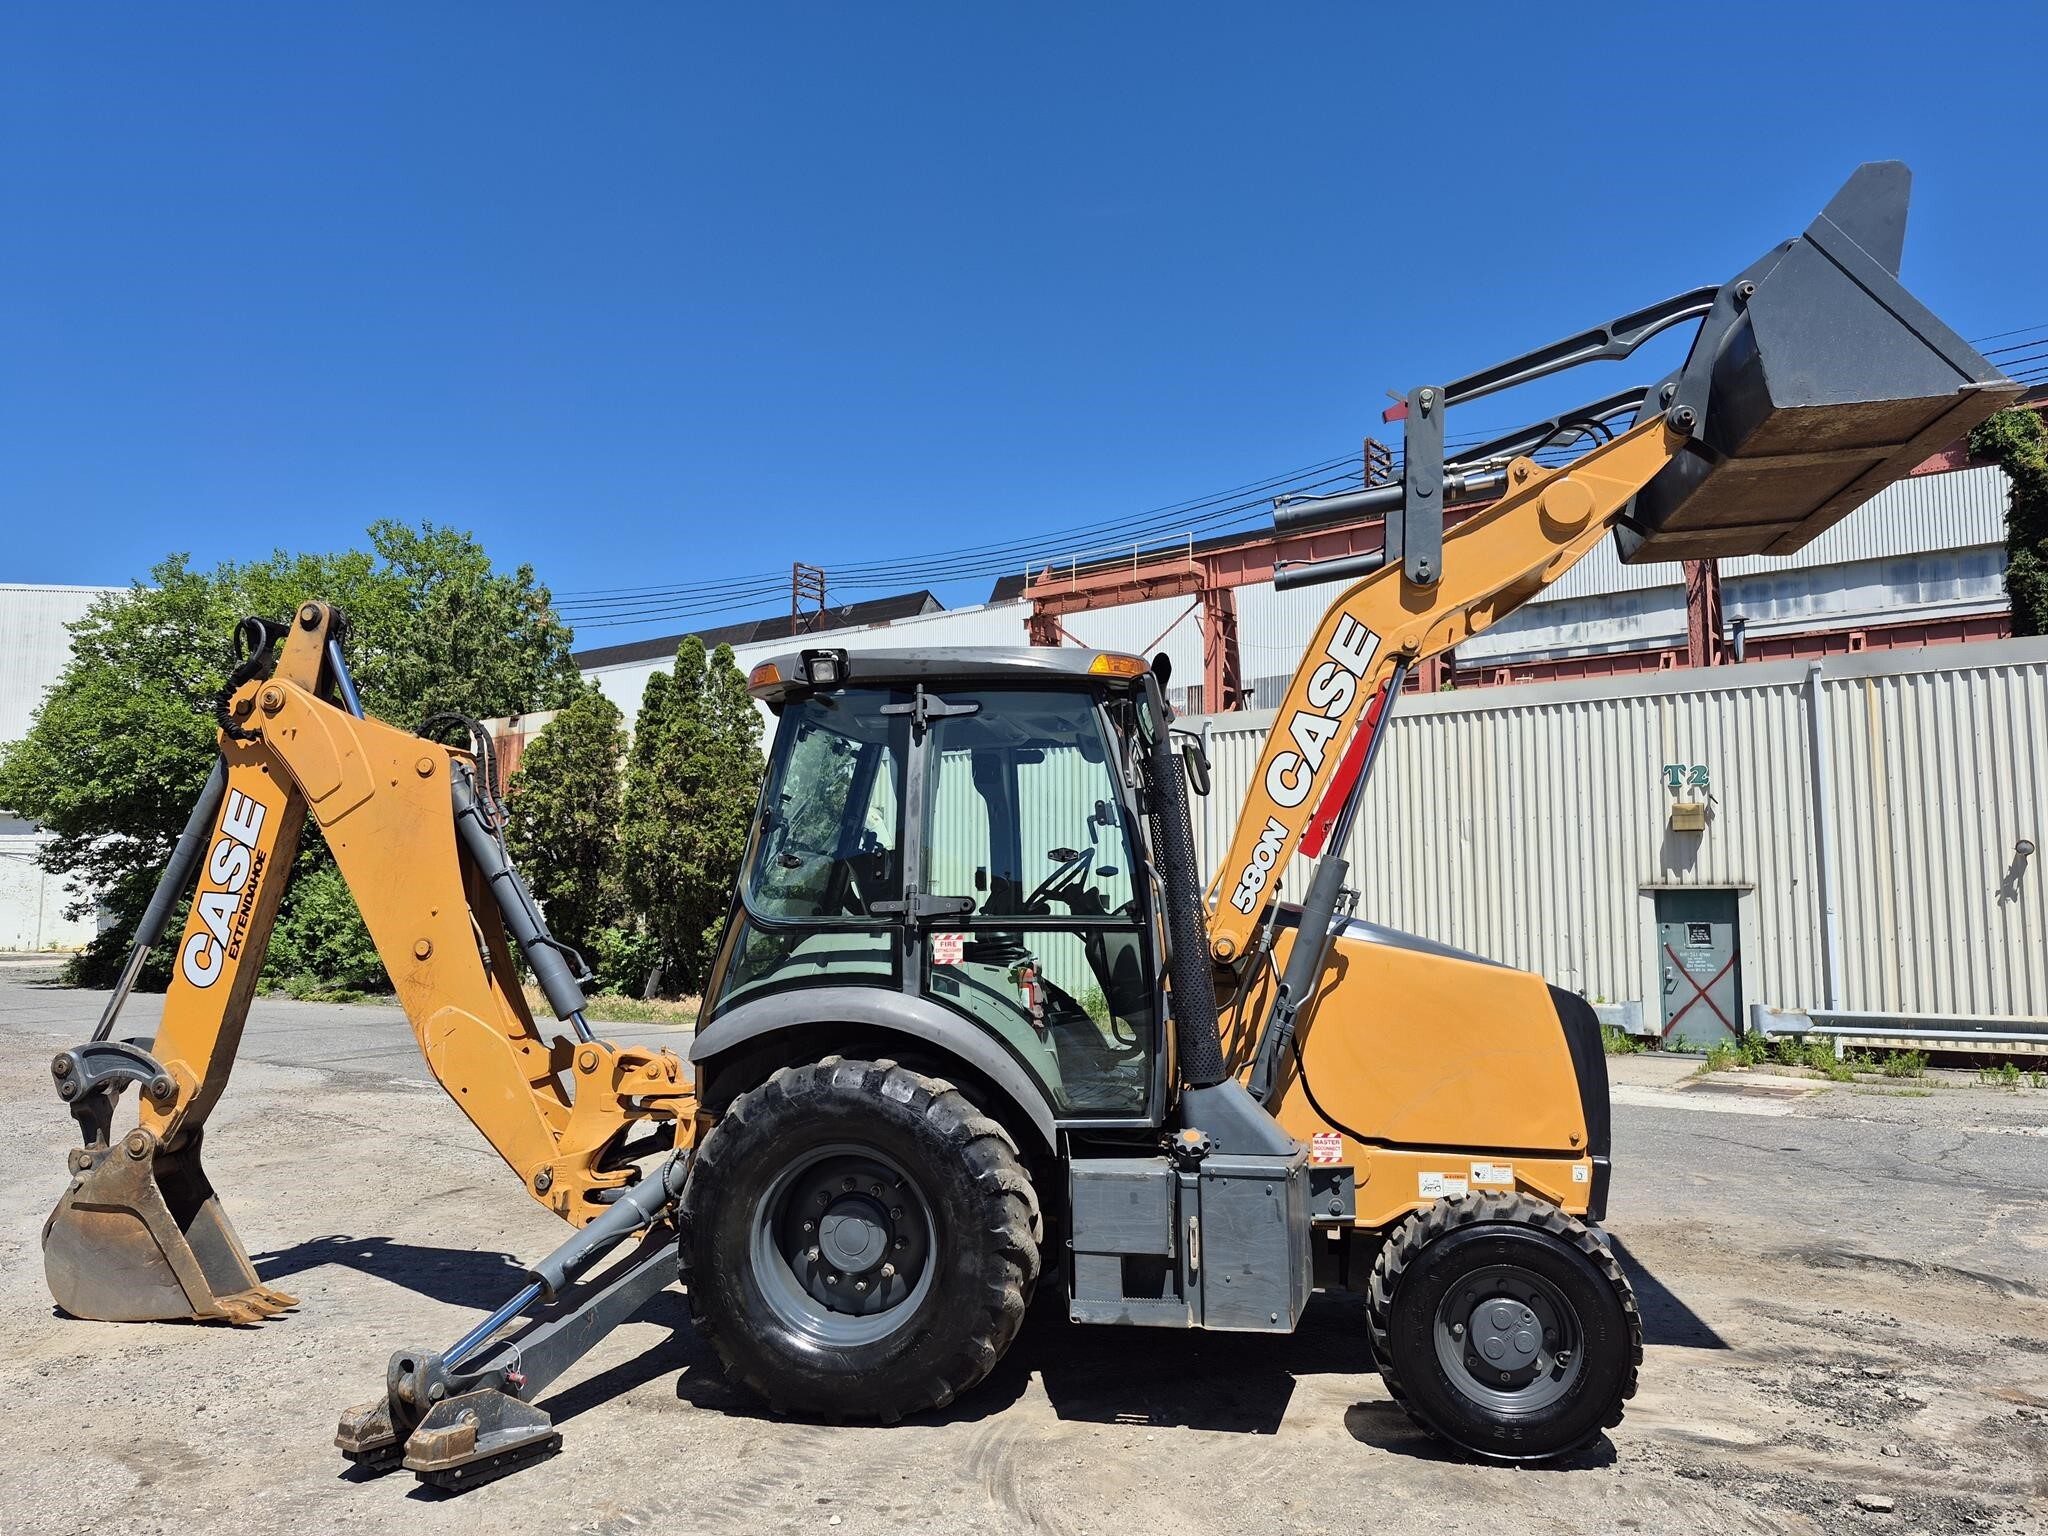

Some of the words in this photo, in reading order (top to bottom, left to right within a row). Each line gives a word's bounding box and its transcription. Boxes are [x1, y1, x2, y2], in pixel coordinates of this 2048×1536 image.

[1265, 611, 1381, 808] CASE
[1663, 764, 1710, 786] T2
[182, 787, 267, 988] CASE
[228, 849, 267, 960] EXTENDAHOE
[1230, 816, 1290, 915] 580N
